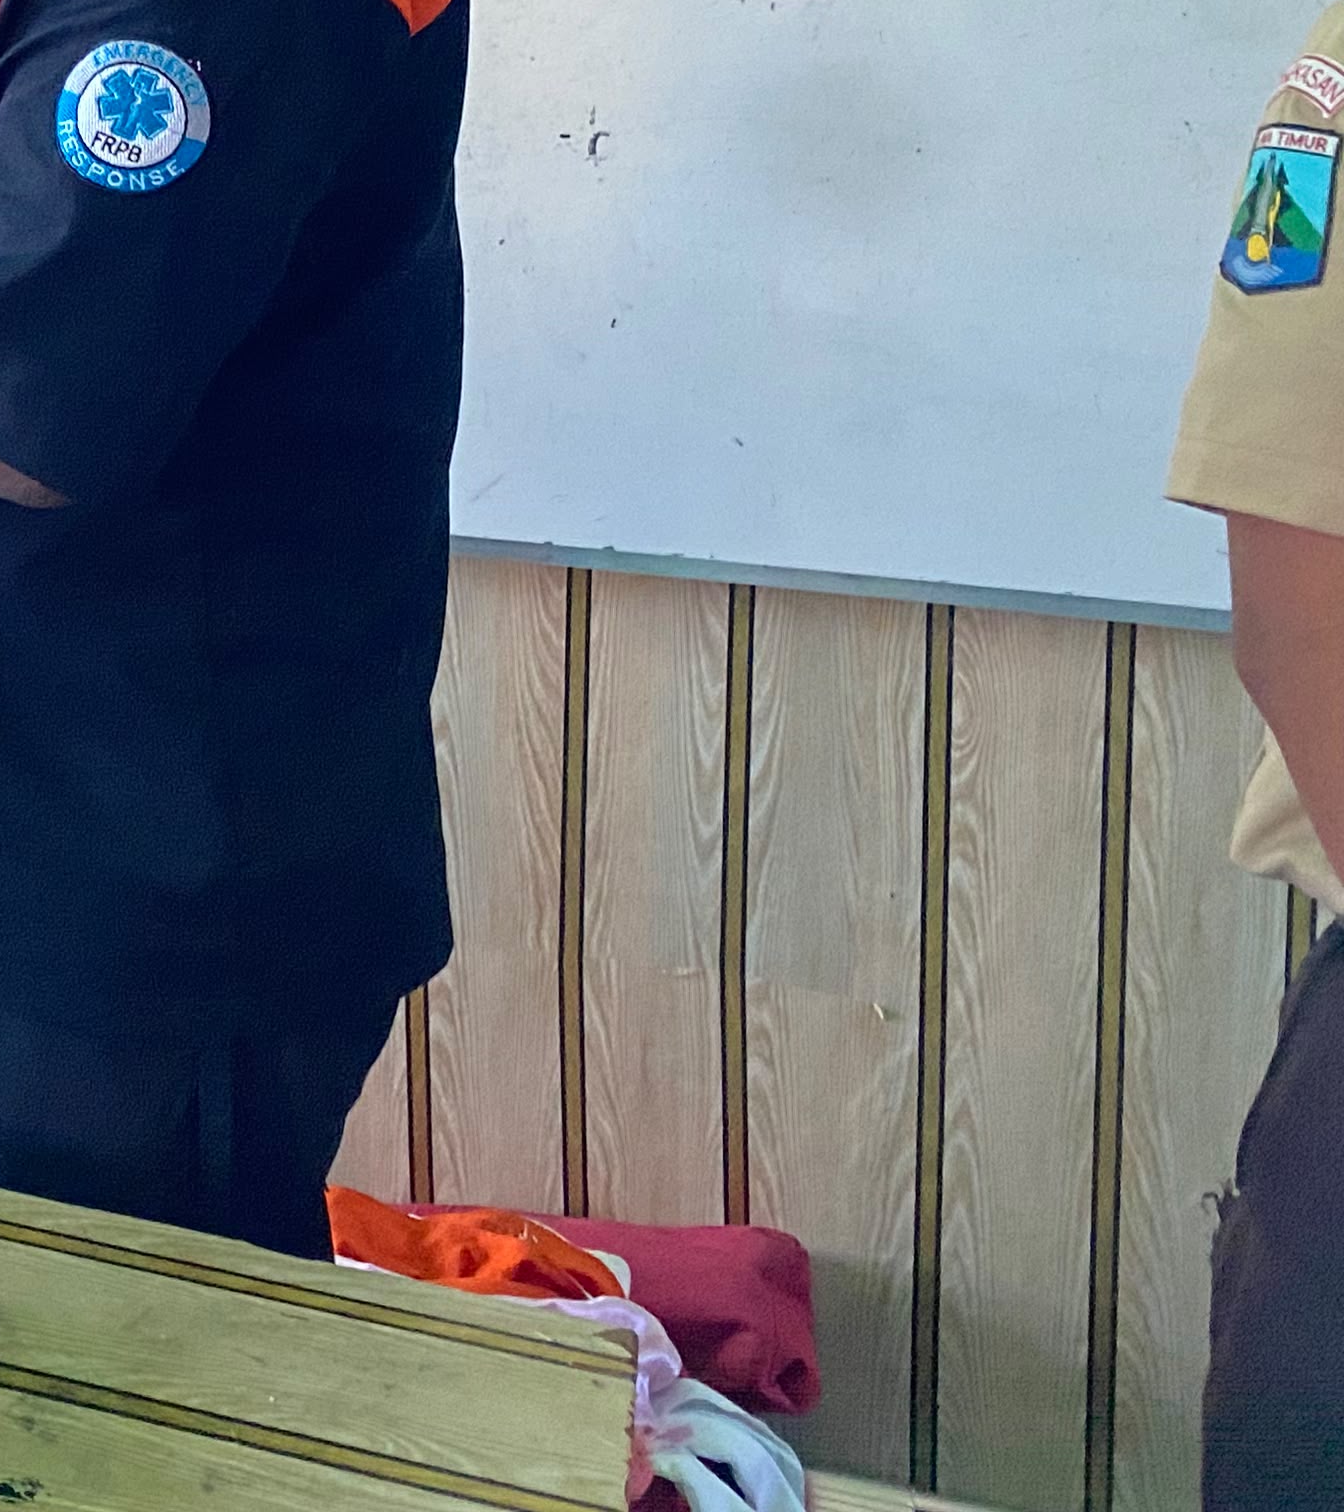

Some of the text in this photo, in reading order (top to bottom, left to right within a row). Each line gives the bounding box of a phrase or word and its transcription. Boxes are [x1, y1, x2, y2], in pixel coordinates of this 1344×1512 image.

[58, 118, 187, 191] RESPONSE
[91, 130, 143, 164] FRPB
[1278, 131, 1329, 153] TIMUR
